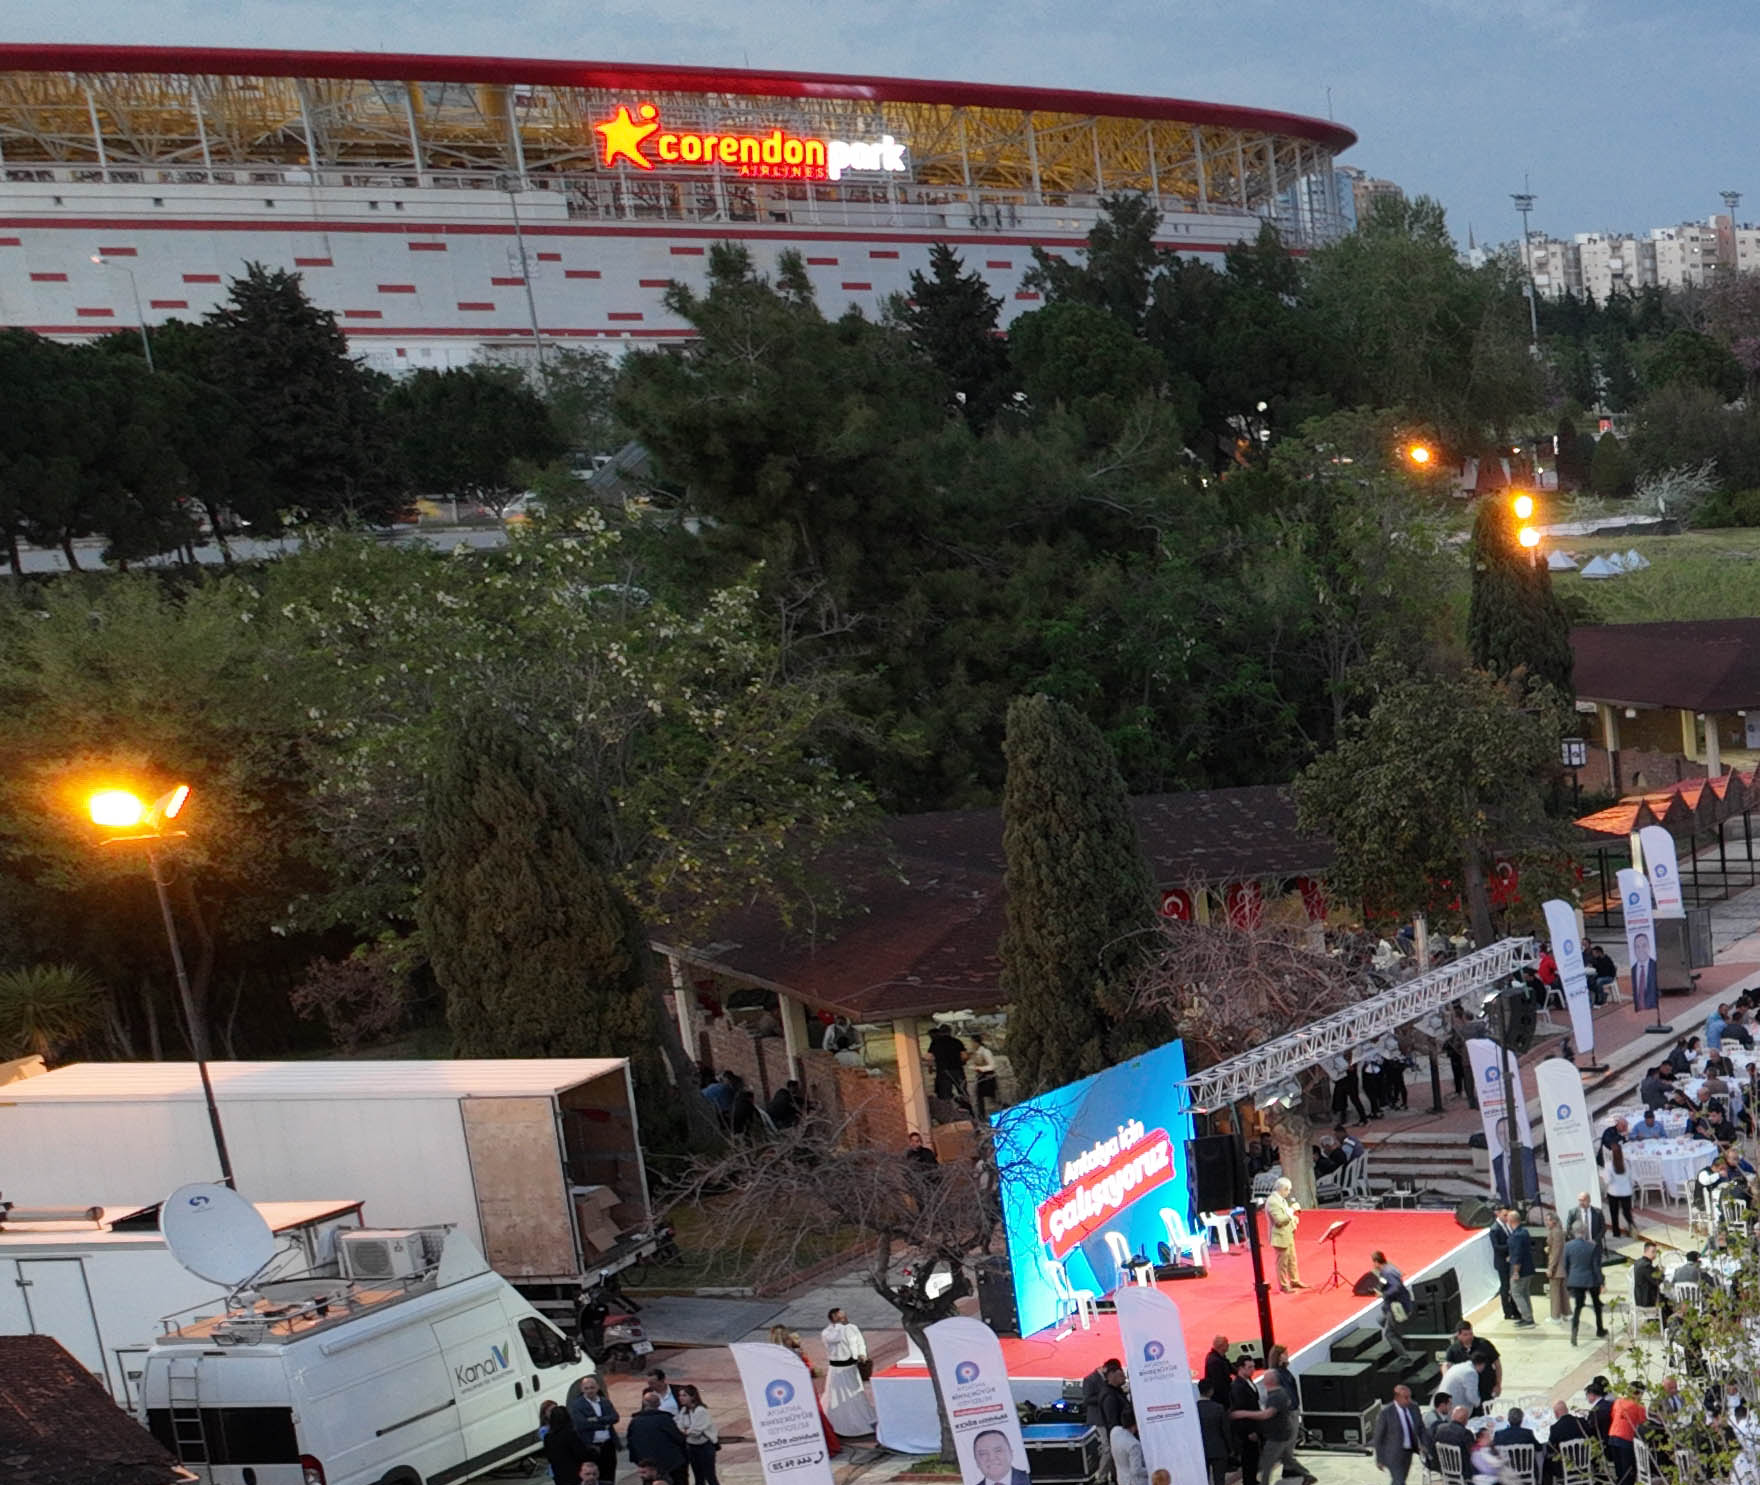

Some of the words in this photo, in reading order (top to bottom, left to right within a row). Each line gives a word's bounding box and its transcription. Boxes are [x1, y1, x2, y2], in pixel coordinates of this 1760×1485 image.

[658, 131, 825, 165] corendon
[828, 136, 906, 181] park
[739, 165, 826, 179] AIRLINES
[1064, 1138, 1119, 1186] Antalya
[1118, 1118, 1145, 1151] için
[1050, 1141, 1168, 1241] çalışıyoruz
